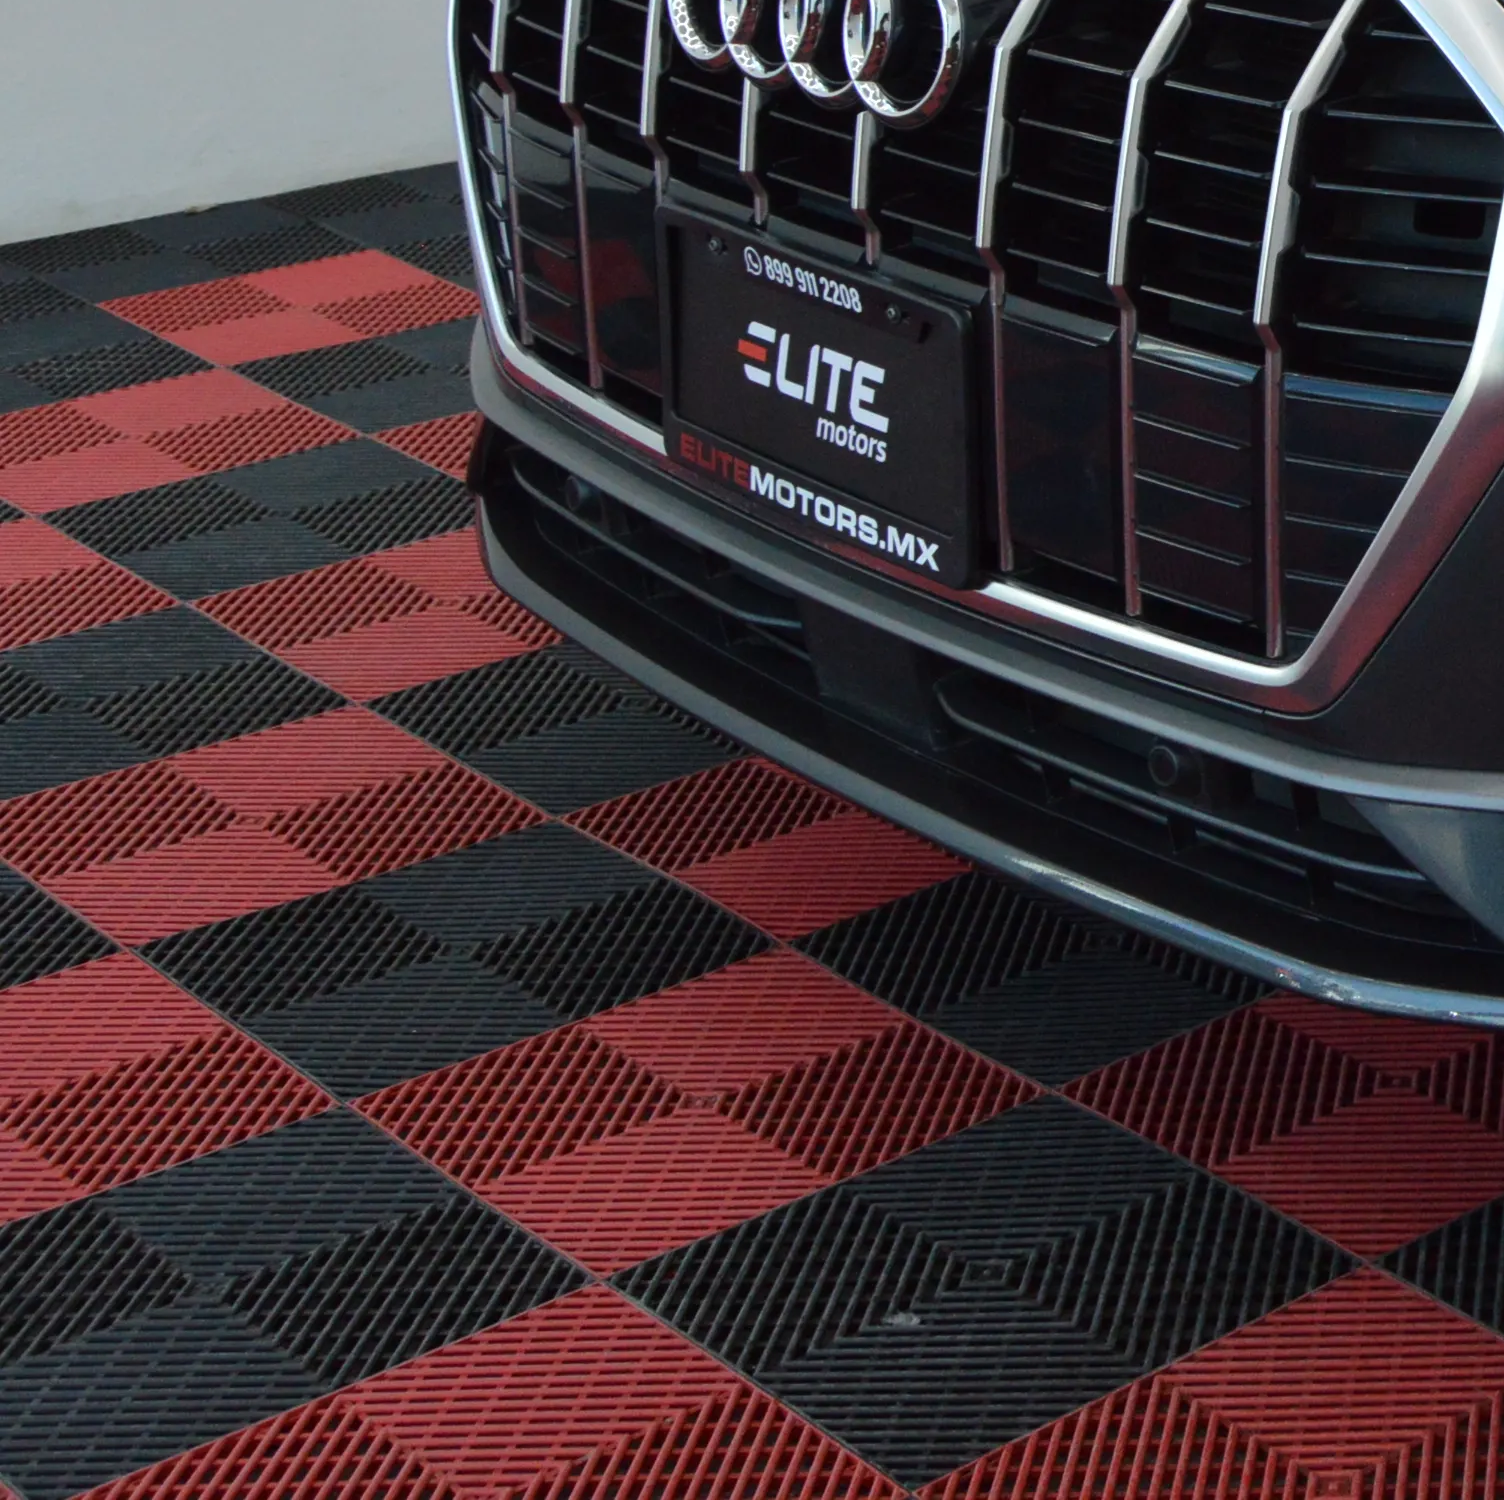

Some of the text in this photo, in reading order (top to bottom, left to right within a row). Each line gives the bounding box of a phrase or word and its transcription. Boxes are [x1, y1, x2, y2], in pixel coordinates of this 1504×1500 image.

[763, 254, 863, 314] 899 911 2208
[737, 321, 890, 434] ELITE
[815, 416, 888, 464] motors
[679, 432, 941, 573] ELITEMOTORS.MX
